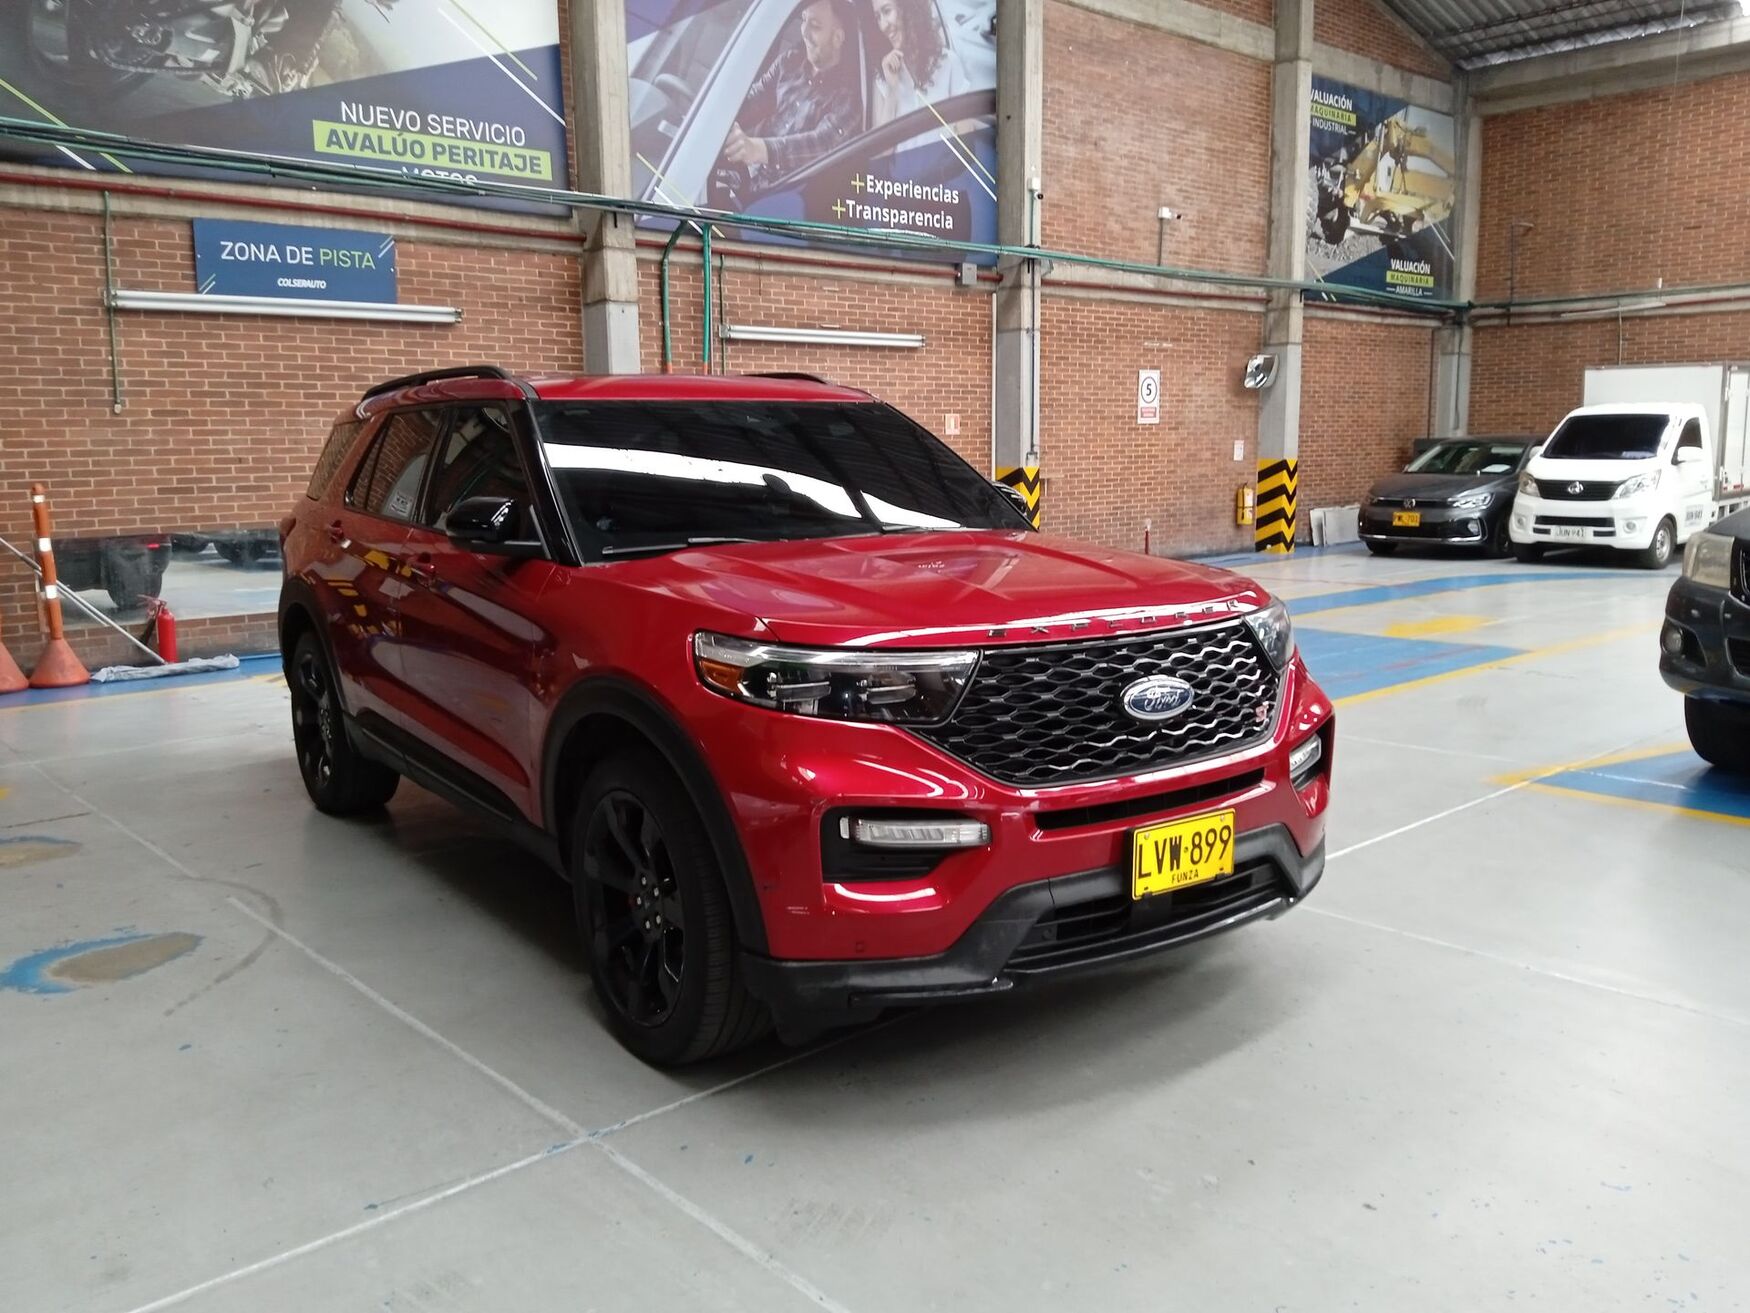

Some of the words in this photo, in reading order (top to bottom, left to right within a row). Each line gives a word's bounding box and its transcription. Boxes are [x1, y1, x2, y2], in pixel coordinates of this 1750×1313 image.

[340, 100, 421, 132] NUEVO
[427, 113, 526, 146] SERVICIO
[1312, 117, 1348, 135] INDUSTRIAL
[326, 128, 426, 159] AVALÚO
[432, 142, 542, 175] PERITAJE
[220, 241, 281, 263] ZONA
[286, 245, 314, 265] DE
[319, 248, 376, 270] PISTA
[1391, 258, 1431, 275] VALUACIÓN
[277, 277, 327, 289] COLSERAUTO
[1390, 273, 1429, 285] MAQUINARIA
[1395, 285, 1423, 297] AMARILLA
[1146, 383, 1152, 396] 5
[1171, 869, 1199, 884] FUNZA
